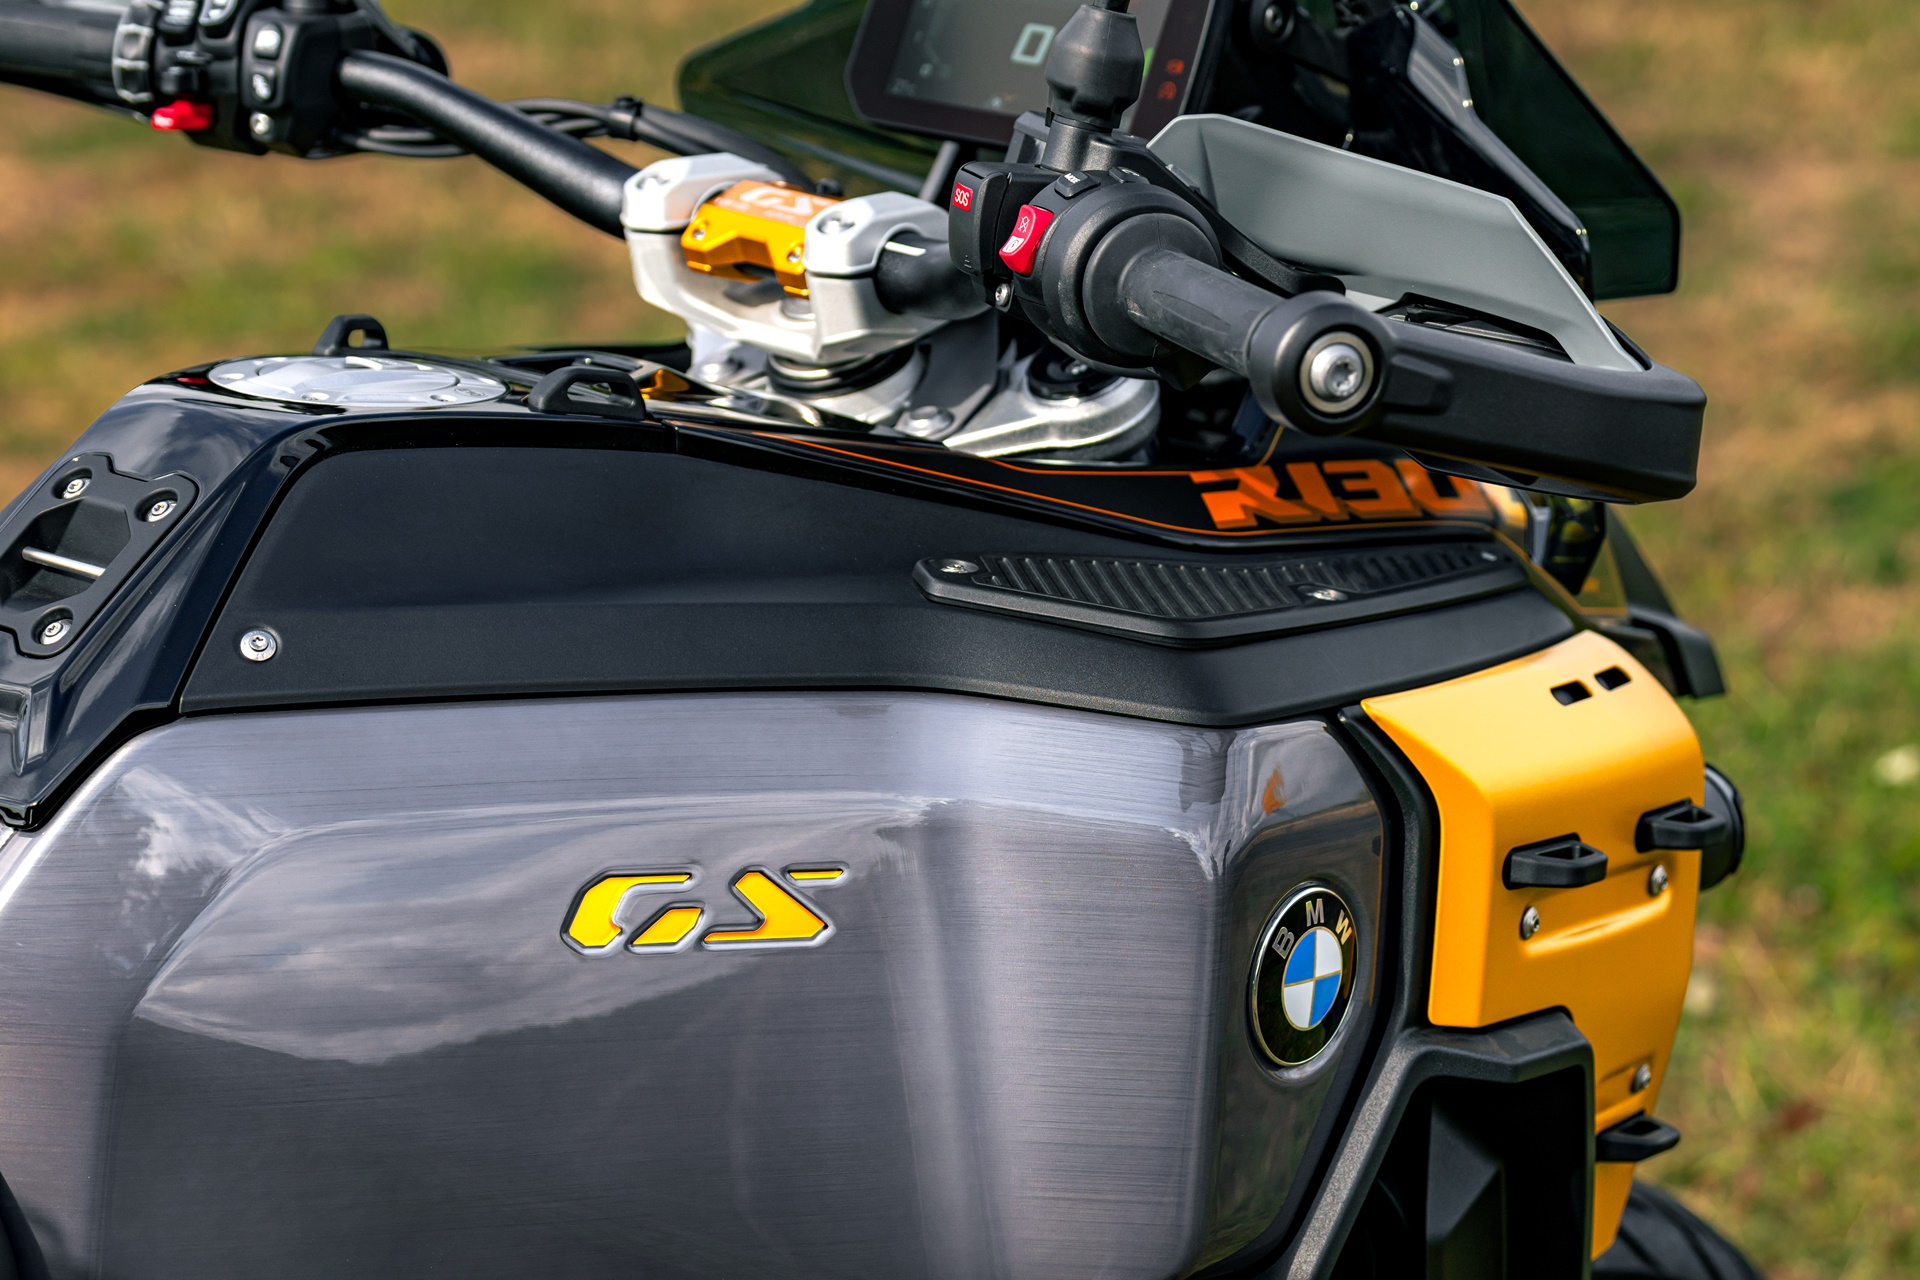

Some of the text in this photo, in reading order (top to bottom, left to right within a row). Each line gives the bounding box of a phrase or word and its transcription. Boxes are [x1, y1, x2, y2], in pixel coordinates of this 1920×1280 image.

[1063, 172, 1081, 184] MODE
[739, 186, 834, 216] GS
[954, 187, 971, 207] SOS
[563, 866, 845, 952] GS
[1271, 898, 1353, 960] BMW
